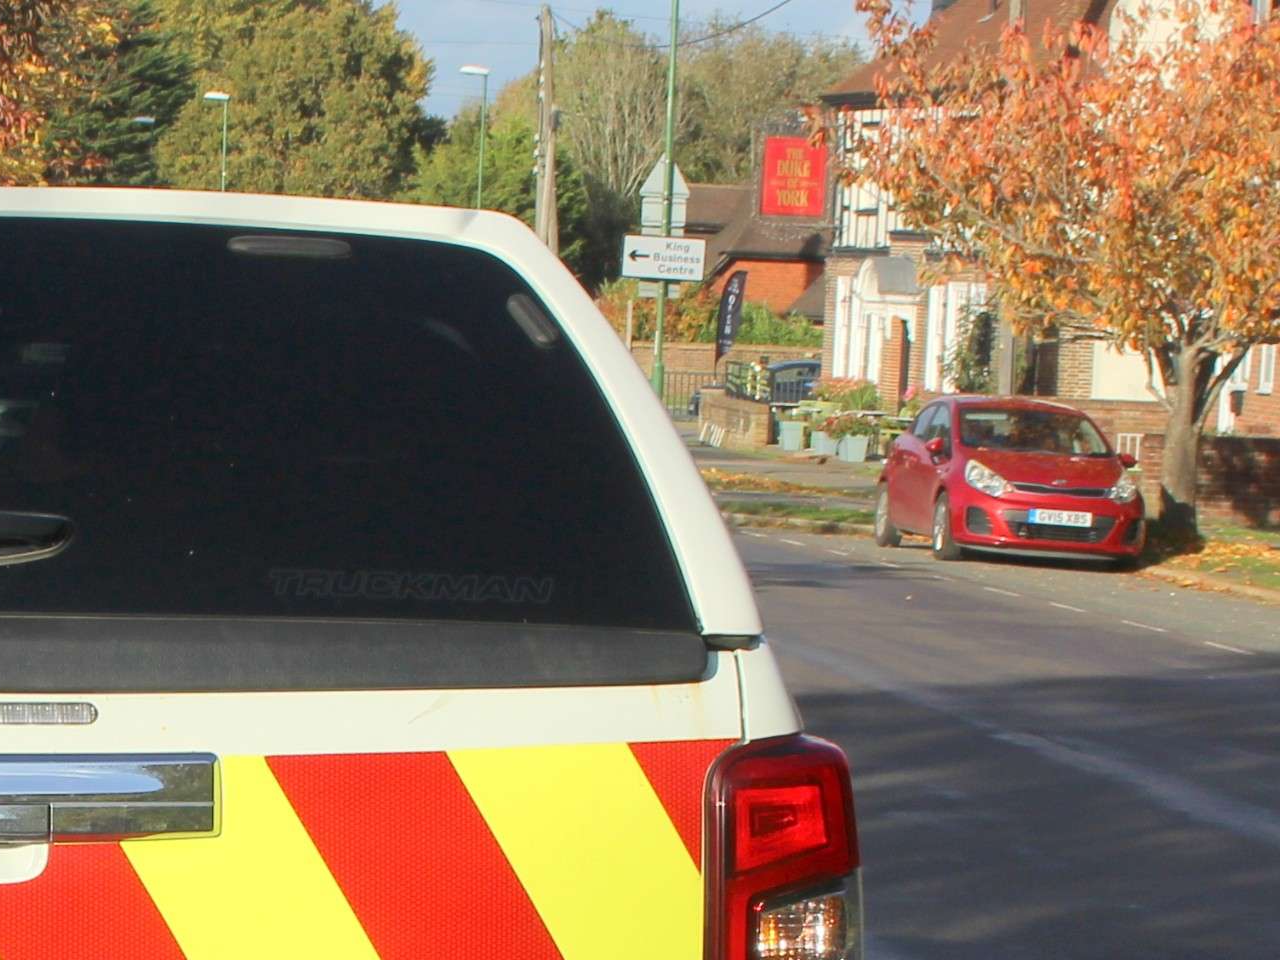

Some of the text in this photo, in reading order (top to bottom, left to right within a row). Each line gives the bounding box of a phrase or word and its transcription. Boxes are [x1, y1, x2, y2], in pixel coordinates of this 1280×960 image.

[776, 160, 812, 177] DUKE
[776, 189, 809, 207] YORK
[665, 241, 690, 253] King
[652, 252, 701, 264] Business
[657, 264, 695, 274] Centre
[269, 568, 554, 603] TRUCKMAN
